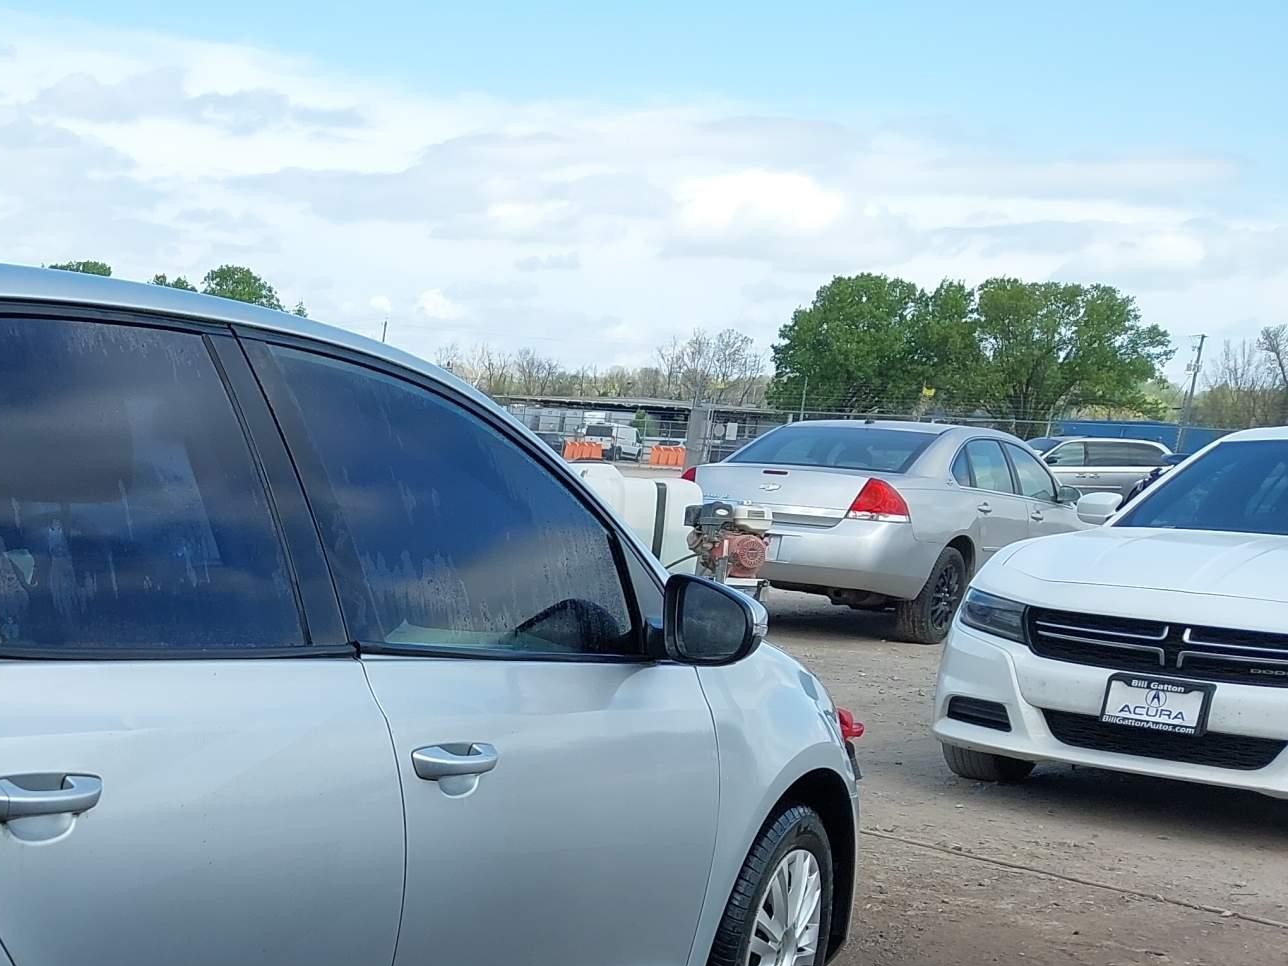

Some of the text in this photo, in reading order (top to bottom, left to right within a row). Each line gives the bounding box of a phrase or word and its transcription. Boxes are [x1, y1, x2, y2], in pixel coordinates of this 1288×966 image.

[1132, 680, 1185, 693] Bill Gatton
[1118, 704, 1185, 721] ACURA
[1102, 714, 1195, 734] BillGattonAutos.com
